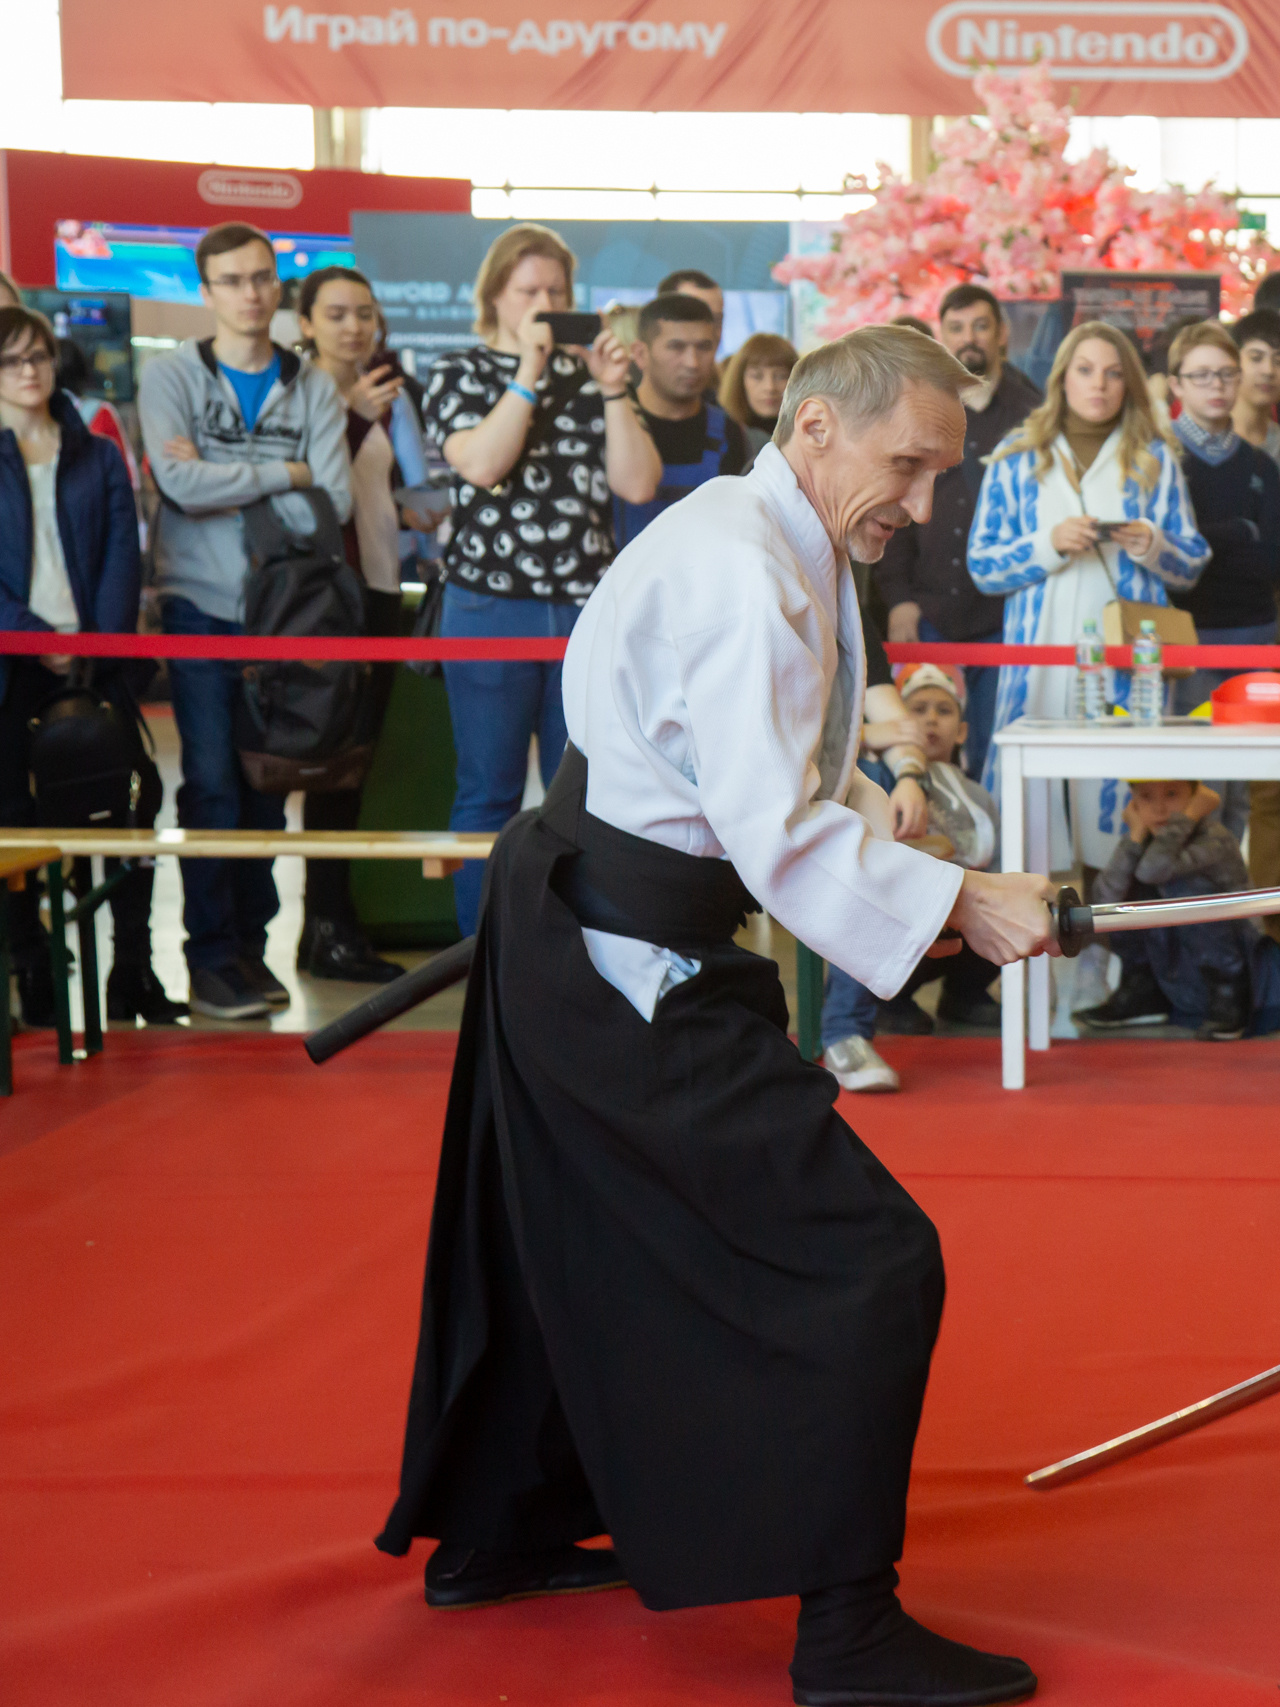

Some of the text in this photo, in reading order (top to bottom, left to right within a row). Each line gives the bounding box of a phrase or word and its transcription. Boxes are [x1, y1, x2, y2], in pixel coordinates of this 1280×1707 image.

[263, 5, 727, 58] Играй по-другому
[957, 19, 1219, 62] Nintendo
